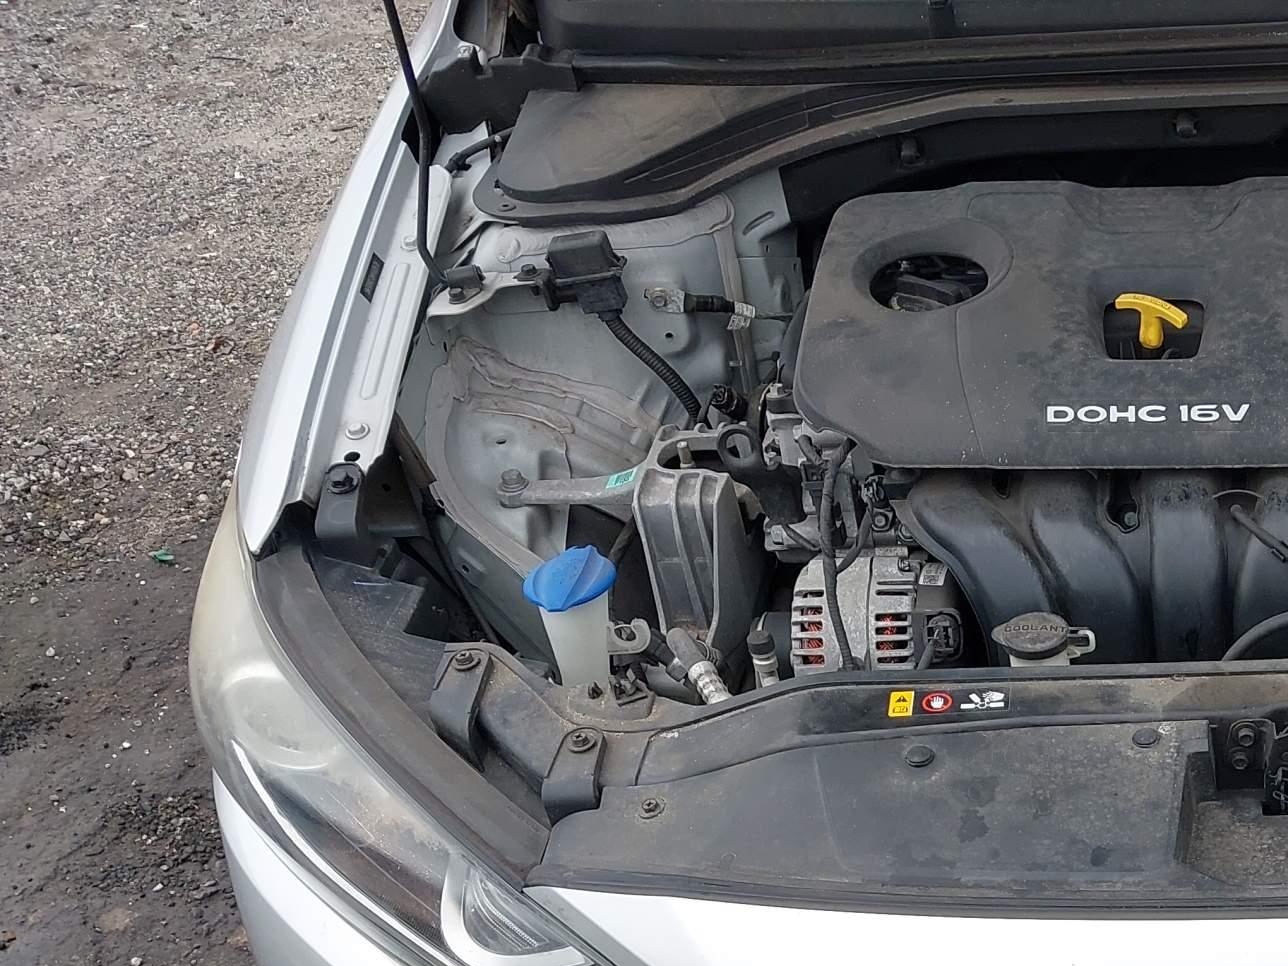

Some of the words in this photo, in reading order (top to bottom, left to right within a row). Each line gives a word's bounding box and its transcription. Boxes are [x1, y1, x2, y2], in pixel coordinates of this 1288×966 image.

[1046, 405, 1167, 423] DOHC
[1179, 403, 1250, 422] 16V
[1004, 623, 1067, 633] COOLANT
